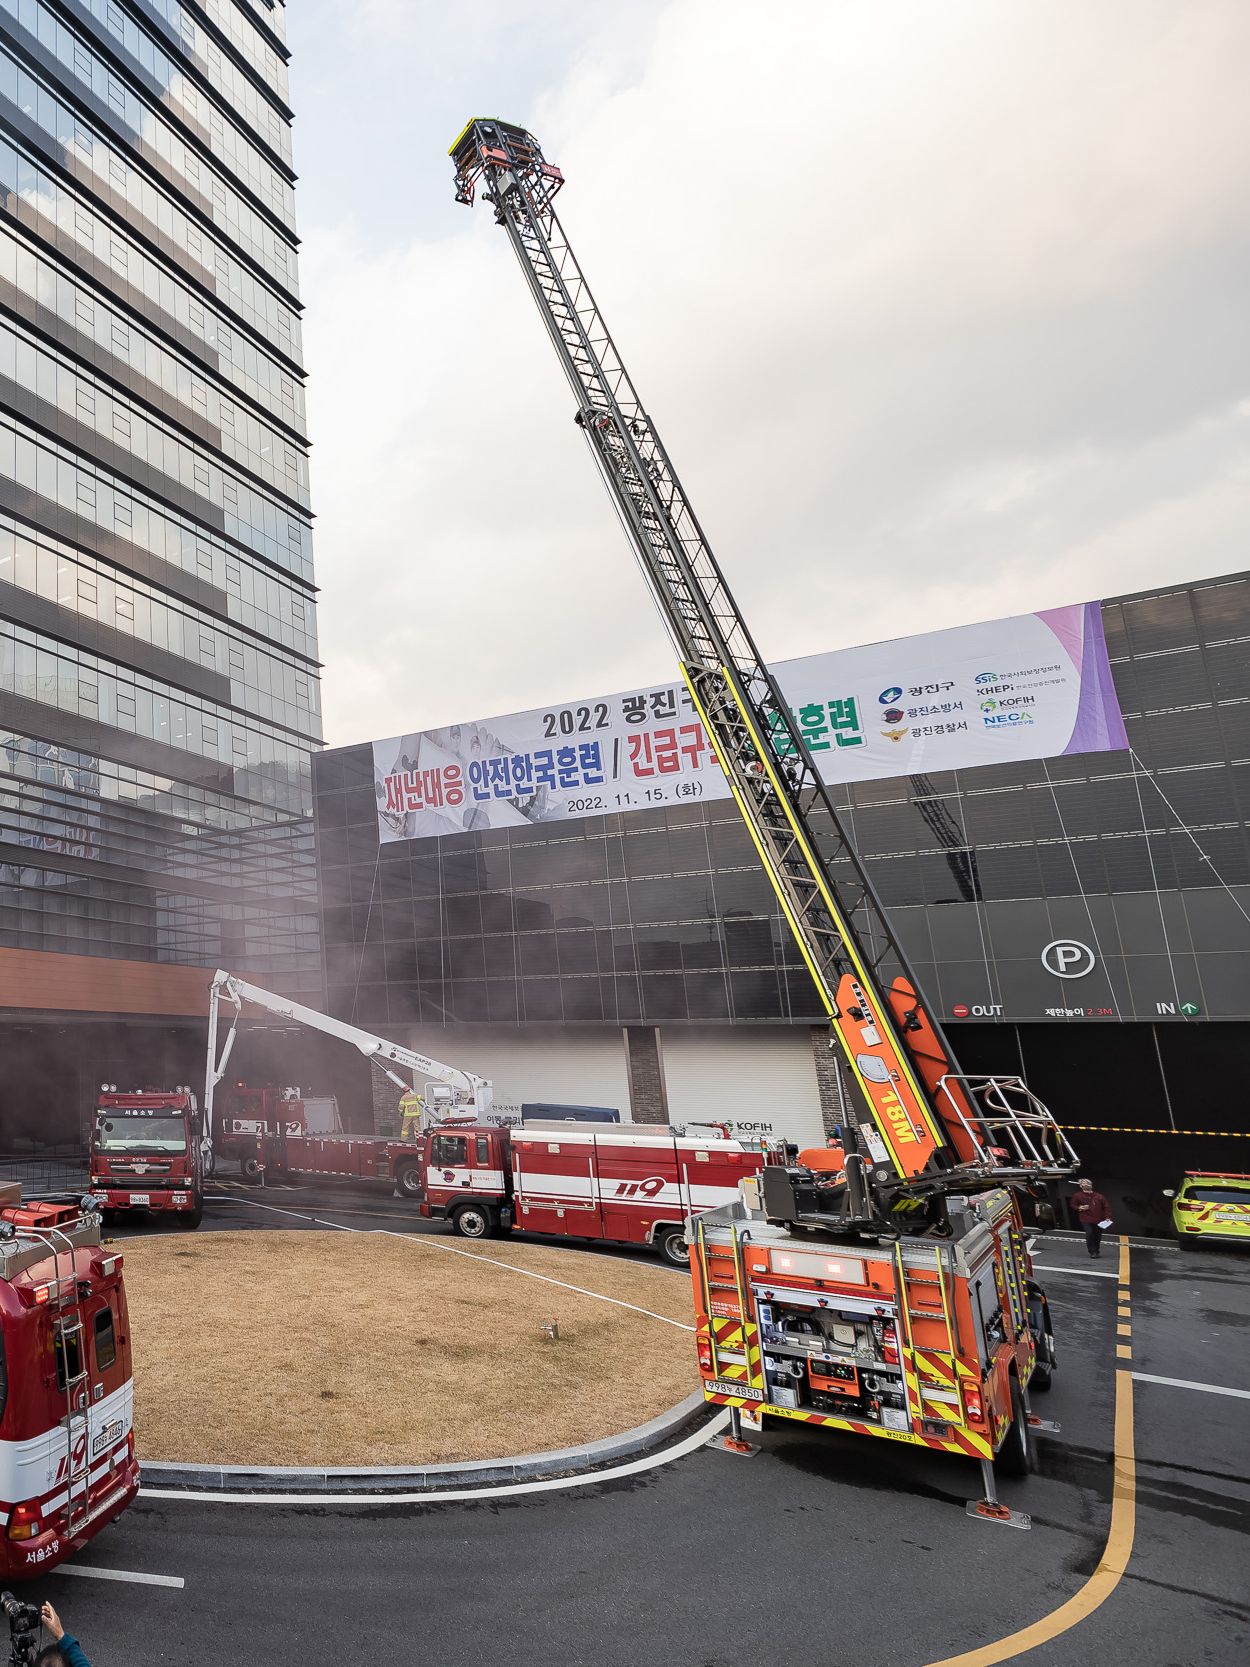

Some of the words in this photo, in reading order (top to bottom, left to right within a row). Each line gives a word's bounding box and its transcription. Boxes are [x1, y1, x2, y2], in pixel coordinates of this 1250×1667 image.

[906, 681, 956, 697] 광진구
[906, 700, 964, 719] 광진소방서
[998, 695, 1035, 707] KOFIH
[542, 703, 610, 739] 2022
[909, 720, 969, 738] 광진경찰서
[384, 763, 464, 812] 재난대응
[468, 741, 603, 802] 안전한국훈련
[612, 737, 619, 779] /
[567, 795, 608, 813] 2022.
[614, 792, 638, 807] 11.
[645, 787, 668, 802] 15.
[675, 780, 704, 799] (화)
[971, 1005, 1003, 1017] OUT
[1044, 1007, 1085, 1017] 제한높이
[1086, 1007, 1113, 1017] 2.3M
[1155, 1002, 1176, 1015] IN
[880, 1090, 917, 1144] 18M
[736, 1121, 773, 1132] KOFIH
[614, 1177, 666, 1200] 119
[734, 1386, 759, 1399] 4850
[767, 1407, 793, 1417] 서울소방
[25, 1540, 60, 1564] 서울소방
